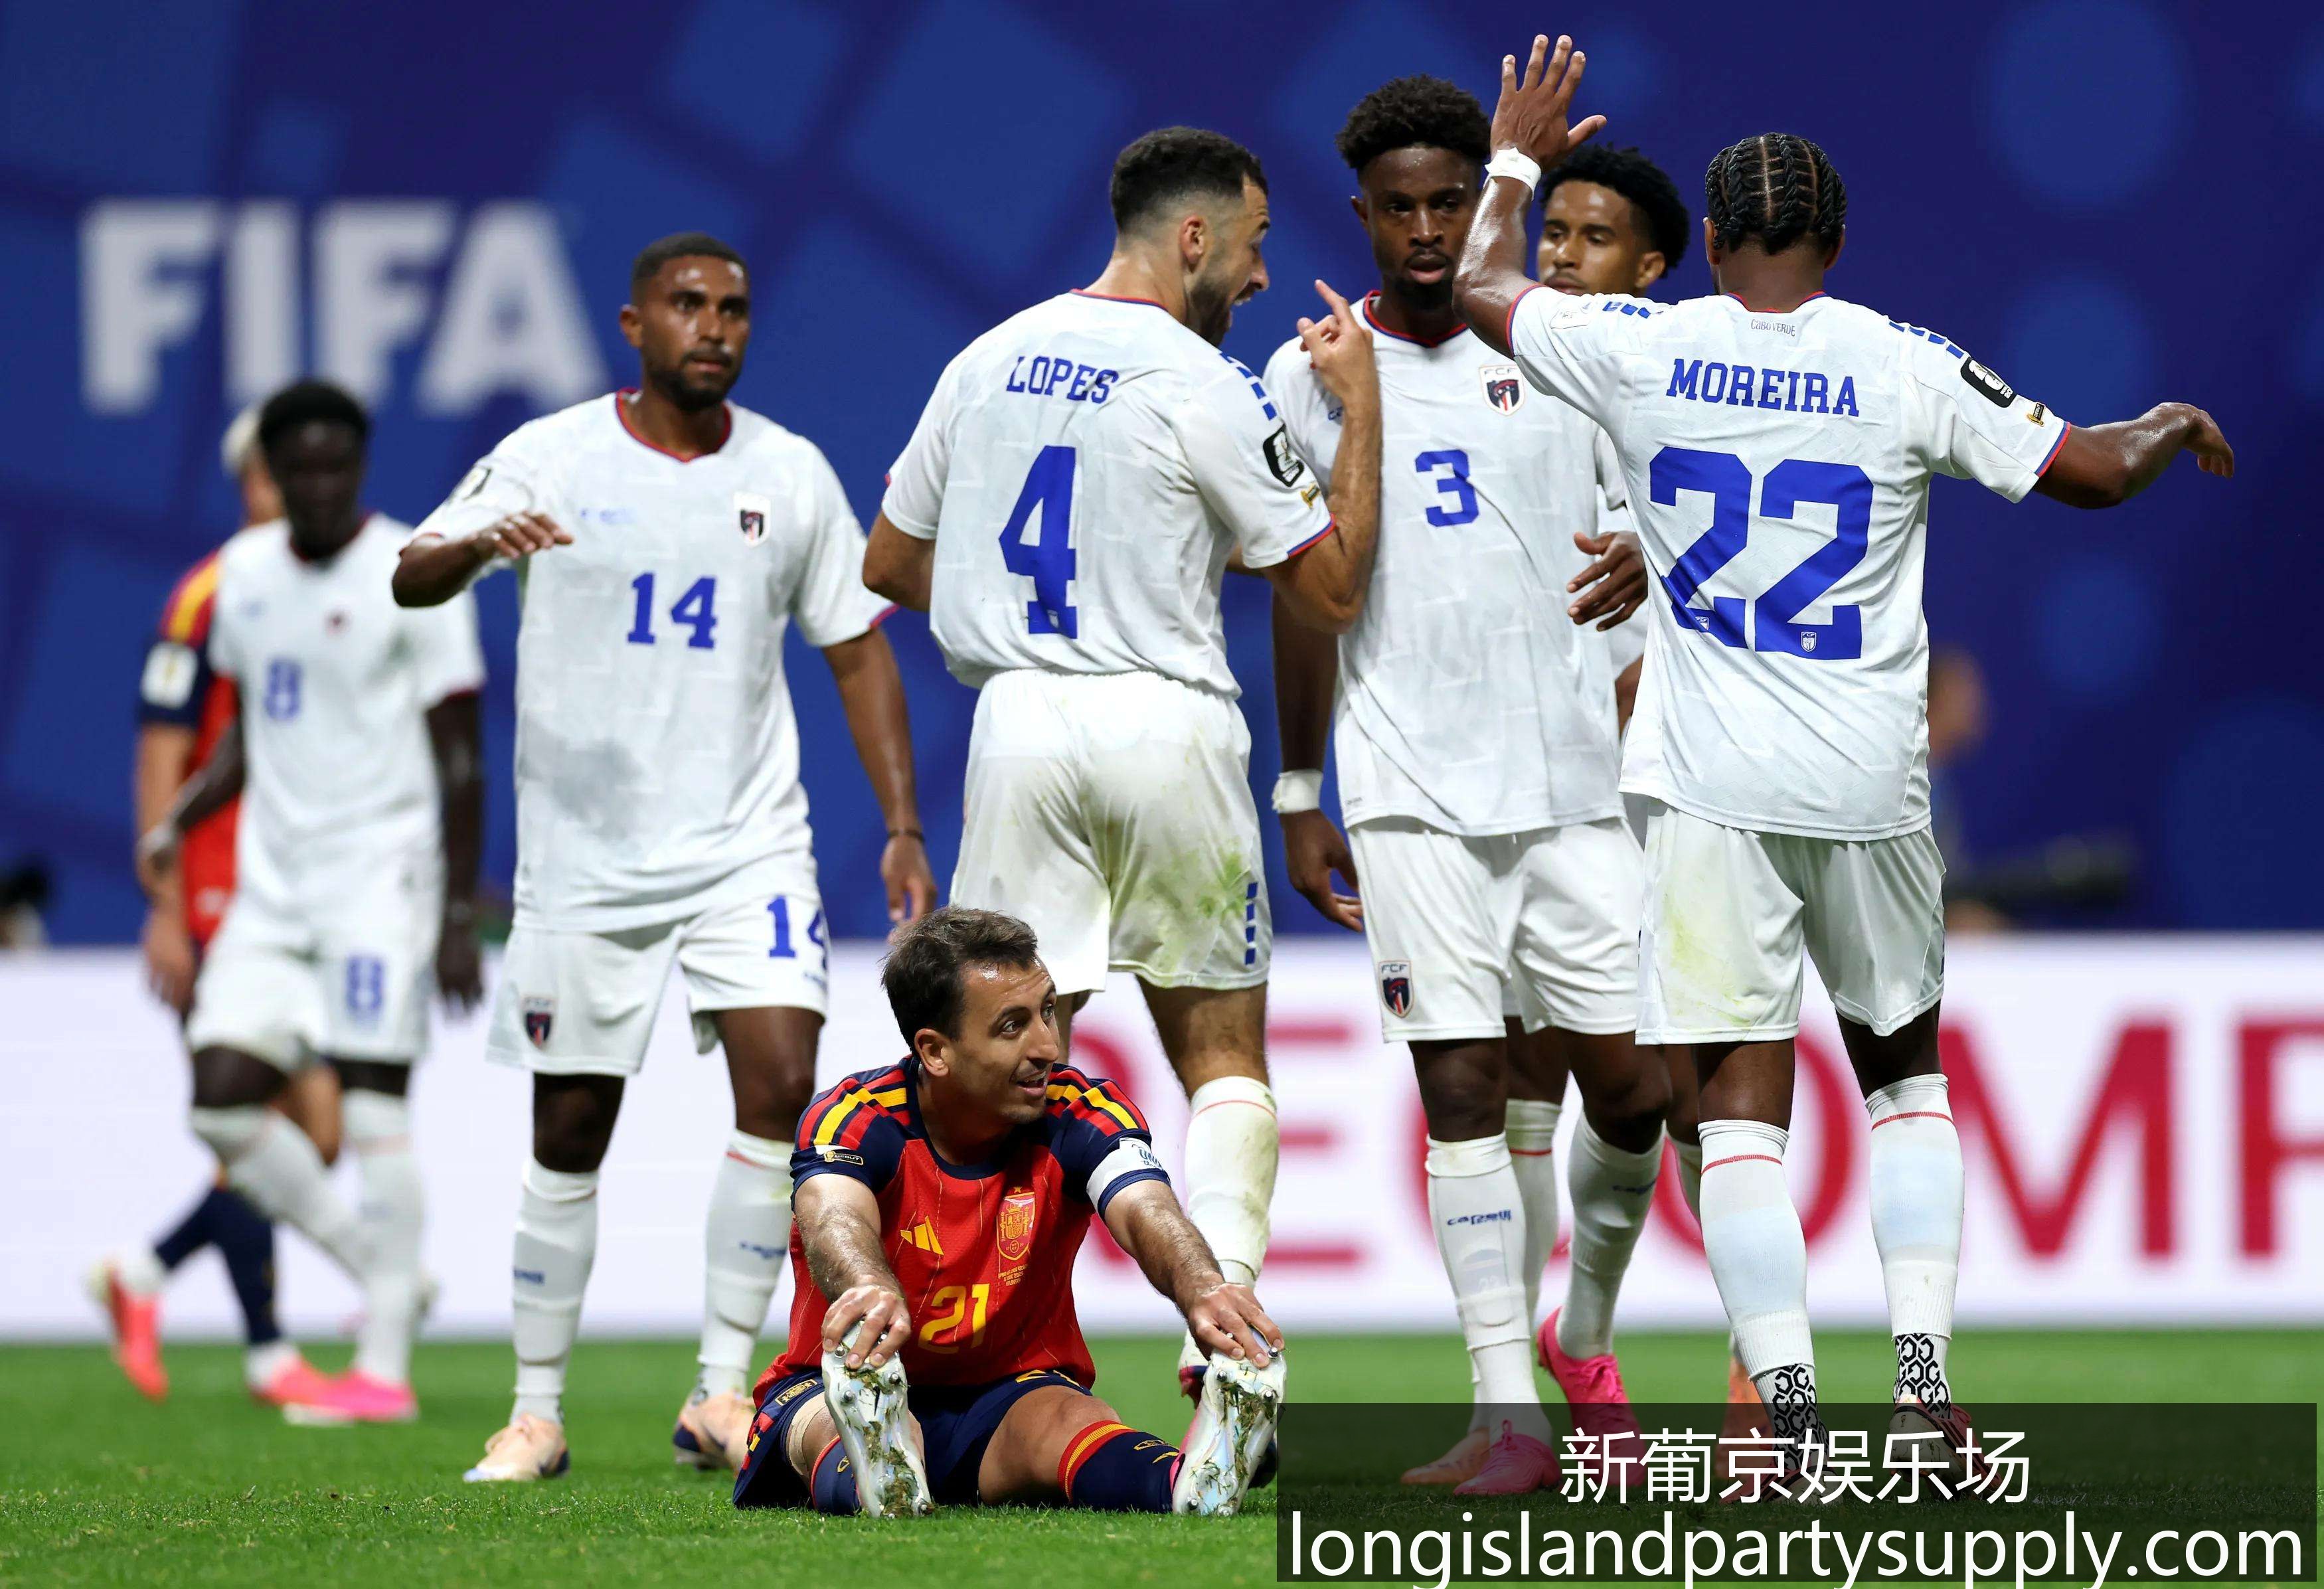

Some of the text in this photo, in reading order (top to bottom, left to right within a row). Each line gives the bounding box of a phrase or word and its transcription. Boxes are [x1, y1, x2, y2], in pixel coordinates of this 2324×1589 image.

[85, 202, 606, 410] FIFA
[1006, 356, 1119, 404] LOPES
[1667, 359, 1859, 417] MOREIRA
[1415, 450, 1479, 527] 3
[999, 445, 1078, 639] 4
[1649, 446, 1873, 661] 22
[627, 572, 718, 649] 14
[262, 654, 305, 726] 8
[345, 952, 387, 1025] 8
[1381, 963, 1407, 974] FCF
[918, 1282, 990, 1355] 21
